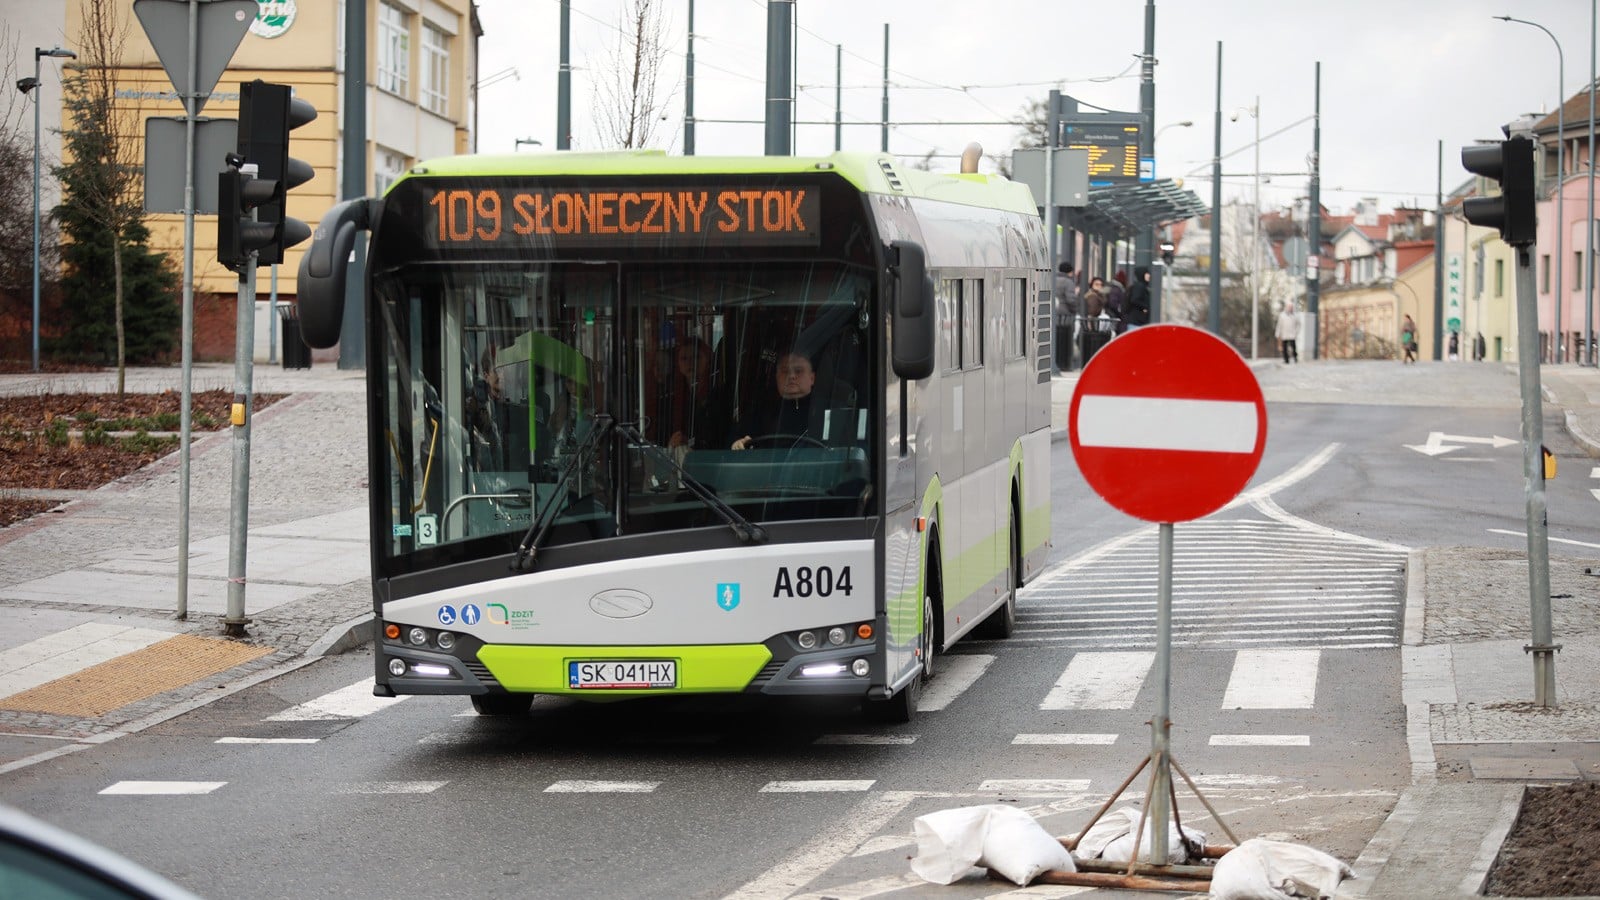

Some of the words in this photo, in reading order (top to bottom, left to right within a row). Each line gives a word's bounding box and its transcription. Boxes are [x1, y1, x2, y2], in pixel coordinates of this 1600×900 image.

[430, 190, 501, 241] 109
[513, 192, 708, 234] SŁONECZNY
[718, 191, 806, 232] STOK
[423, 523, 432, 538] 3
[773, 566, 853, 597] A804
[582, 664, 606, 682] SK
[615, 664, 671, 682] 041HX
